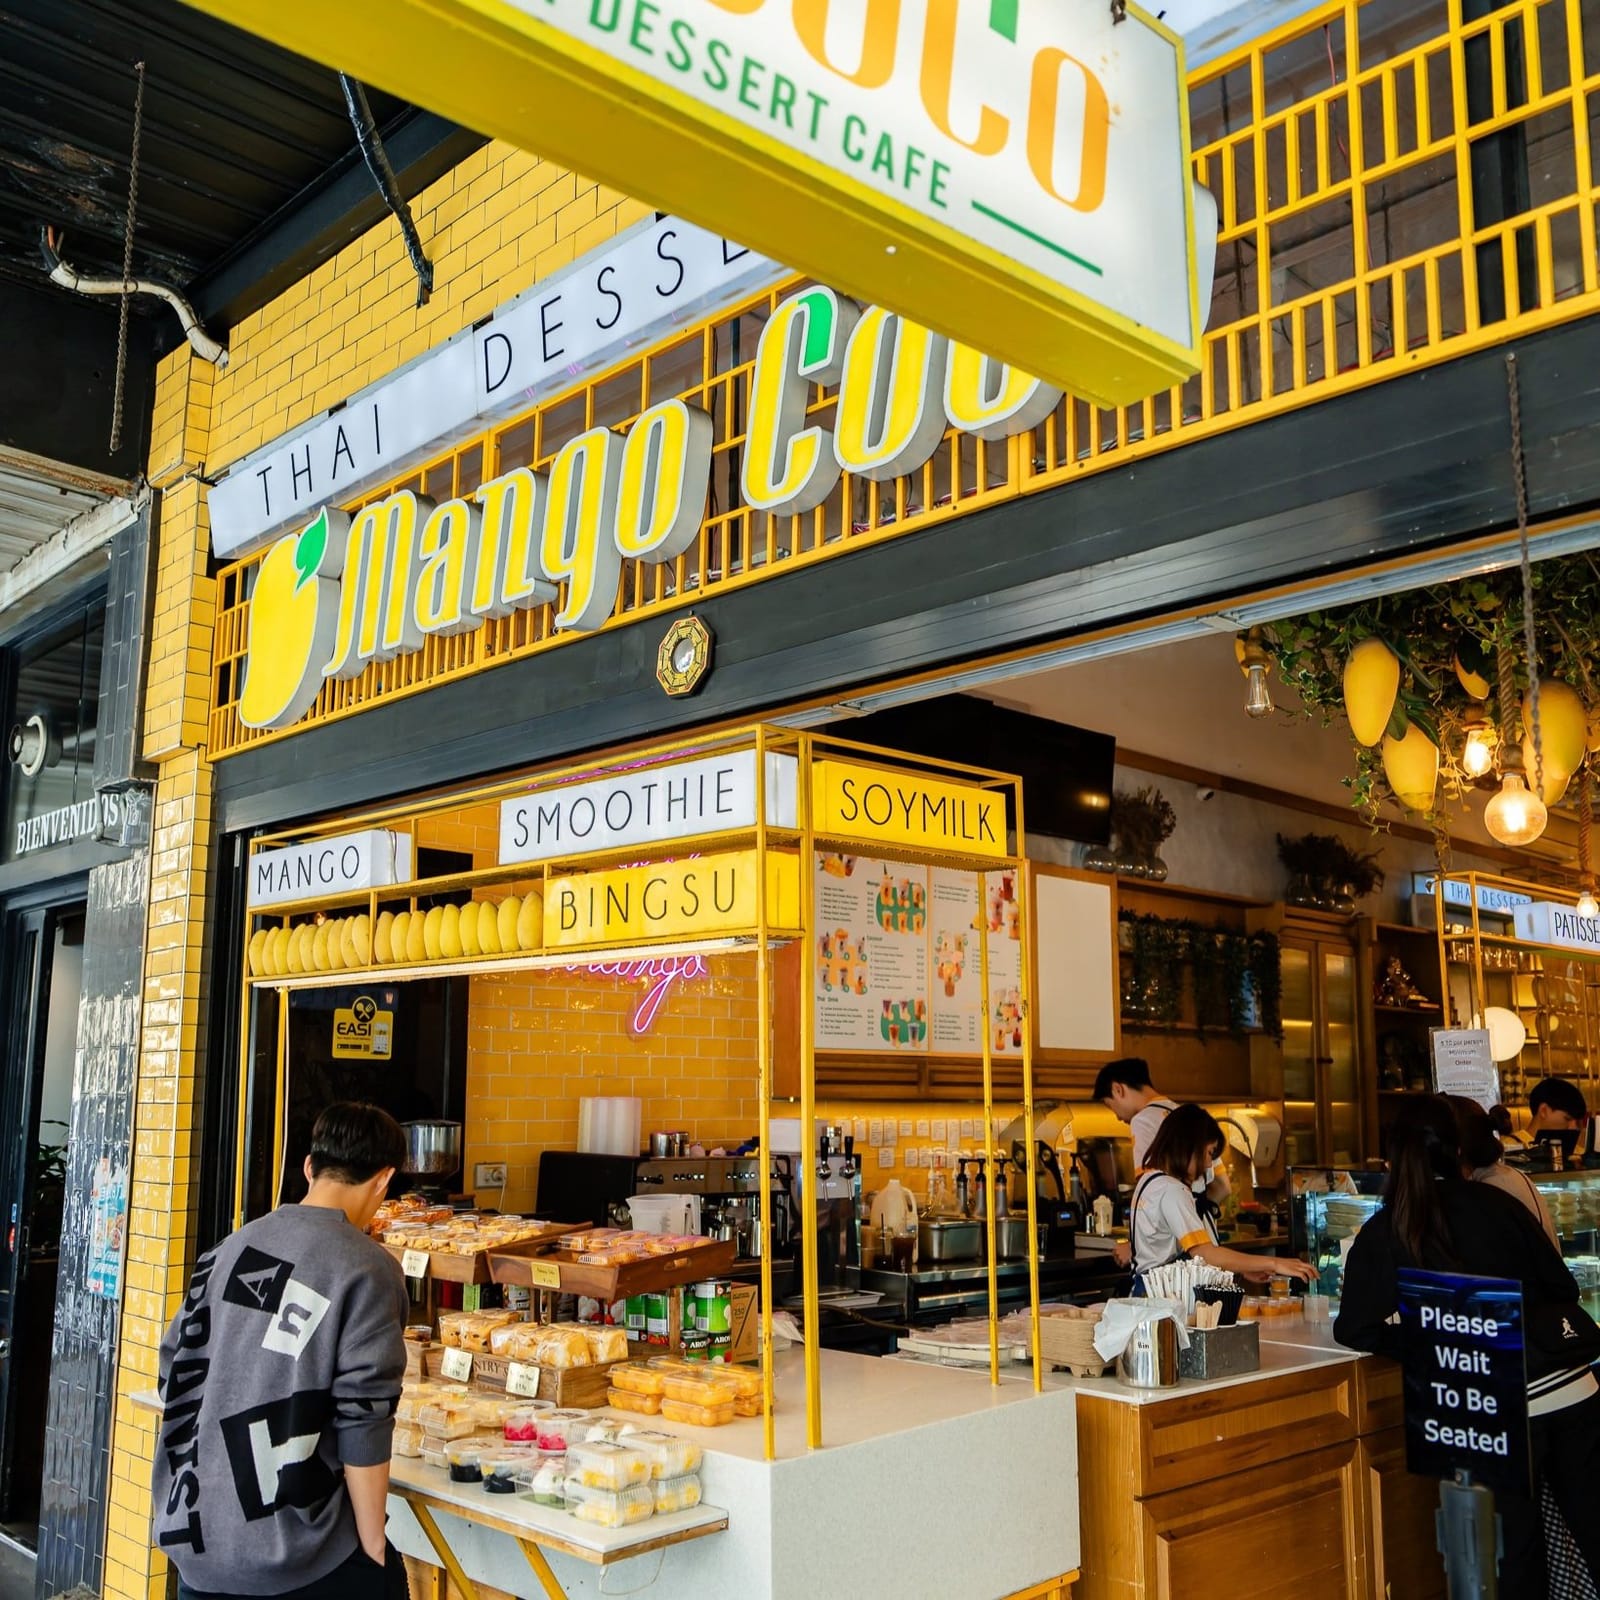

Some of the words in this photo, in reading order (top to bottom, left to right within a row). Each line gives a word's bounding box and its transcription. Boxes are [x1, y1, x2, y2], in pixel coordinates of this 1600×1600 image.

[589, 0, 830, 141] DESSERT
[841, 113, 951, 210] CAFE
[256, 403, 382, 516] THAI
[322, 397, 702, 680] Mango
[741, 284, 1048, 513] Co
[514, 769, 734, 848] SMOOTHIE
[840, 778, 996, 843] SOYMILK
[257, 845, 360, 896] MANGO
[560, 867, 735, 931] BINGSU
[1481, 888, 1528, 910] DESSE
[1554, 911, 1600, 944] PATISSE
[337, 1022, 372, 1037] EASI
[1420, 1305, 1499, 1338] Please
[1434, 1345, 1491, 1375] Wait
[1430, 1381, 1460, 1408] To
[1465, 1387, 1498, 1415] Be
[1424, 1418, 1509, 1456] Seated
